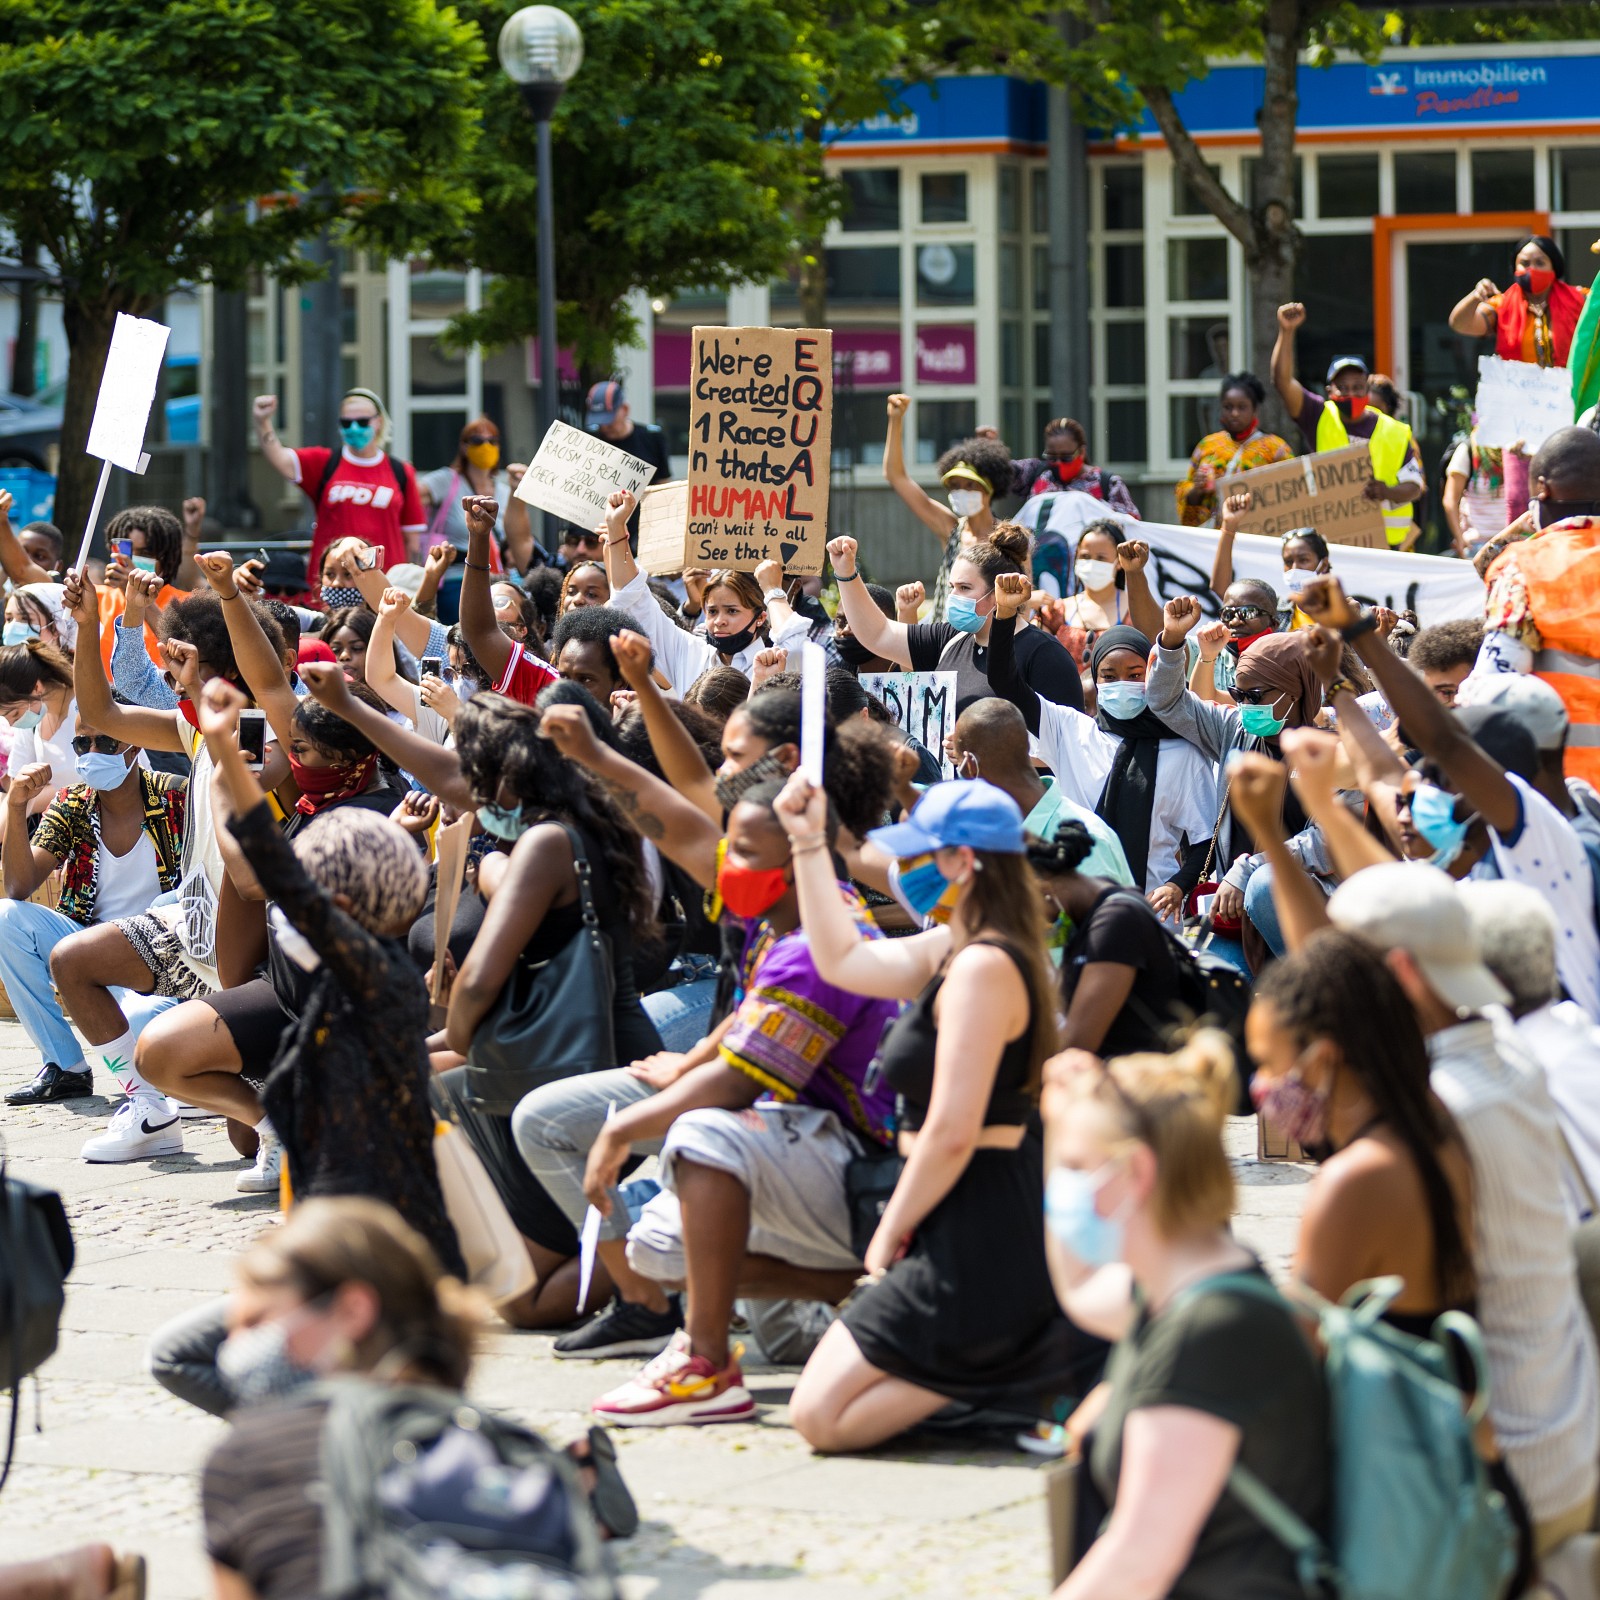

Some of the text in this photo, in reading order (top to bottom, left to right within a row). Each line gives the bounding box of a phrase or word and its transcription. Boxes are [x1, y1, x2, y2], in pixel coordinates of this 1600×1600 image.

[1413, 62, 1547, 85] Immobilien
[699, 338, 773, 378] We're
[696, 373, 790, 408] Created
[694, 410, 786, 448] 1 Race
[785, 337, 823, 521] EQUAL
[543, 440, 641, 493] RACISM IS REAL IN
[551, 424, 564, 436] IF
[563, 428, 583, 446] YOU
[620, 453, 650, 476] THINK
[692, 448, 786, 486] n thats
[328, 484, 374, 505] SPD
[530, 465, 559, 488] CHECK
[560, 479, 582, 499] YOUR
[581, 488, 608, 510] PRIVIL
[570, 469, 596, 487] 2020
[691, 484, 788, 520] HUMAN
[689, 519, 808, 541] can't wait to all
[697, 539, 770, 560] See that
